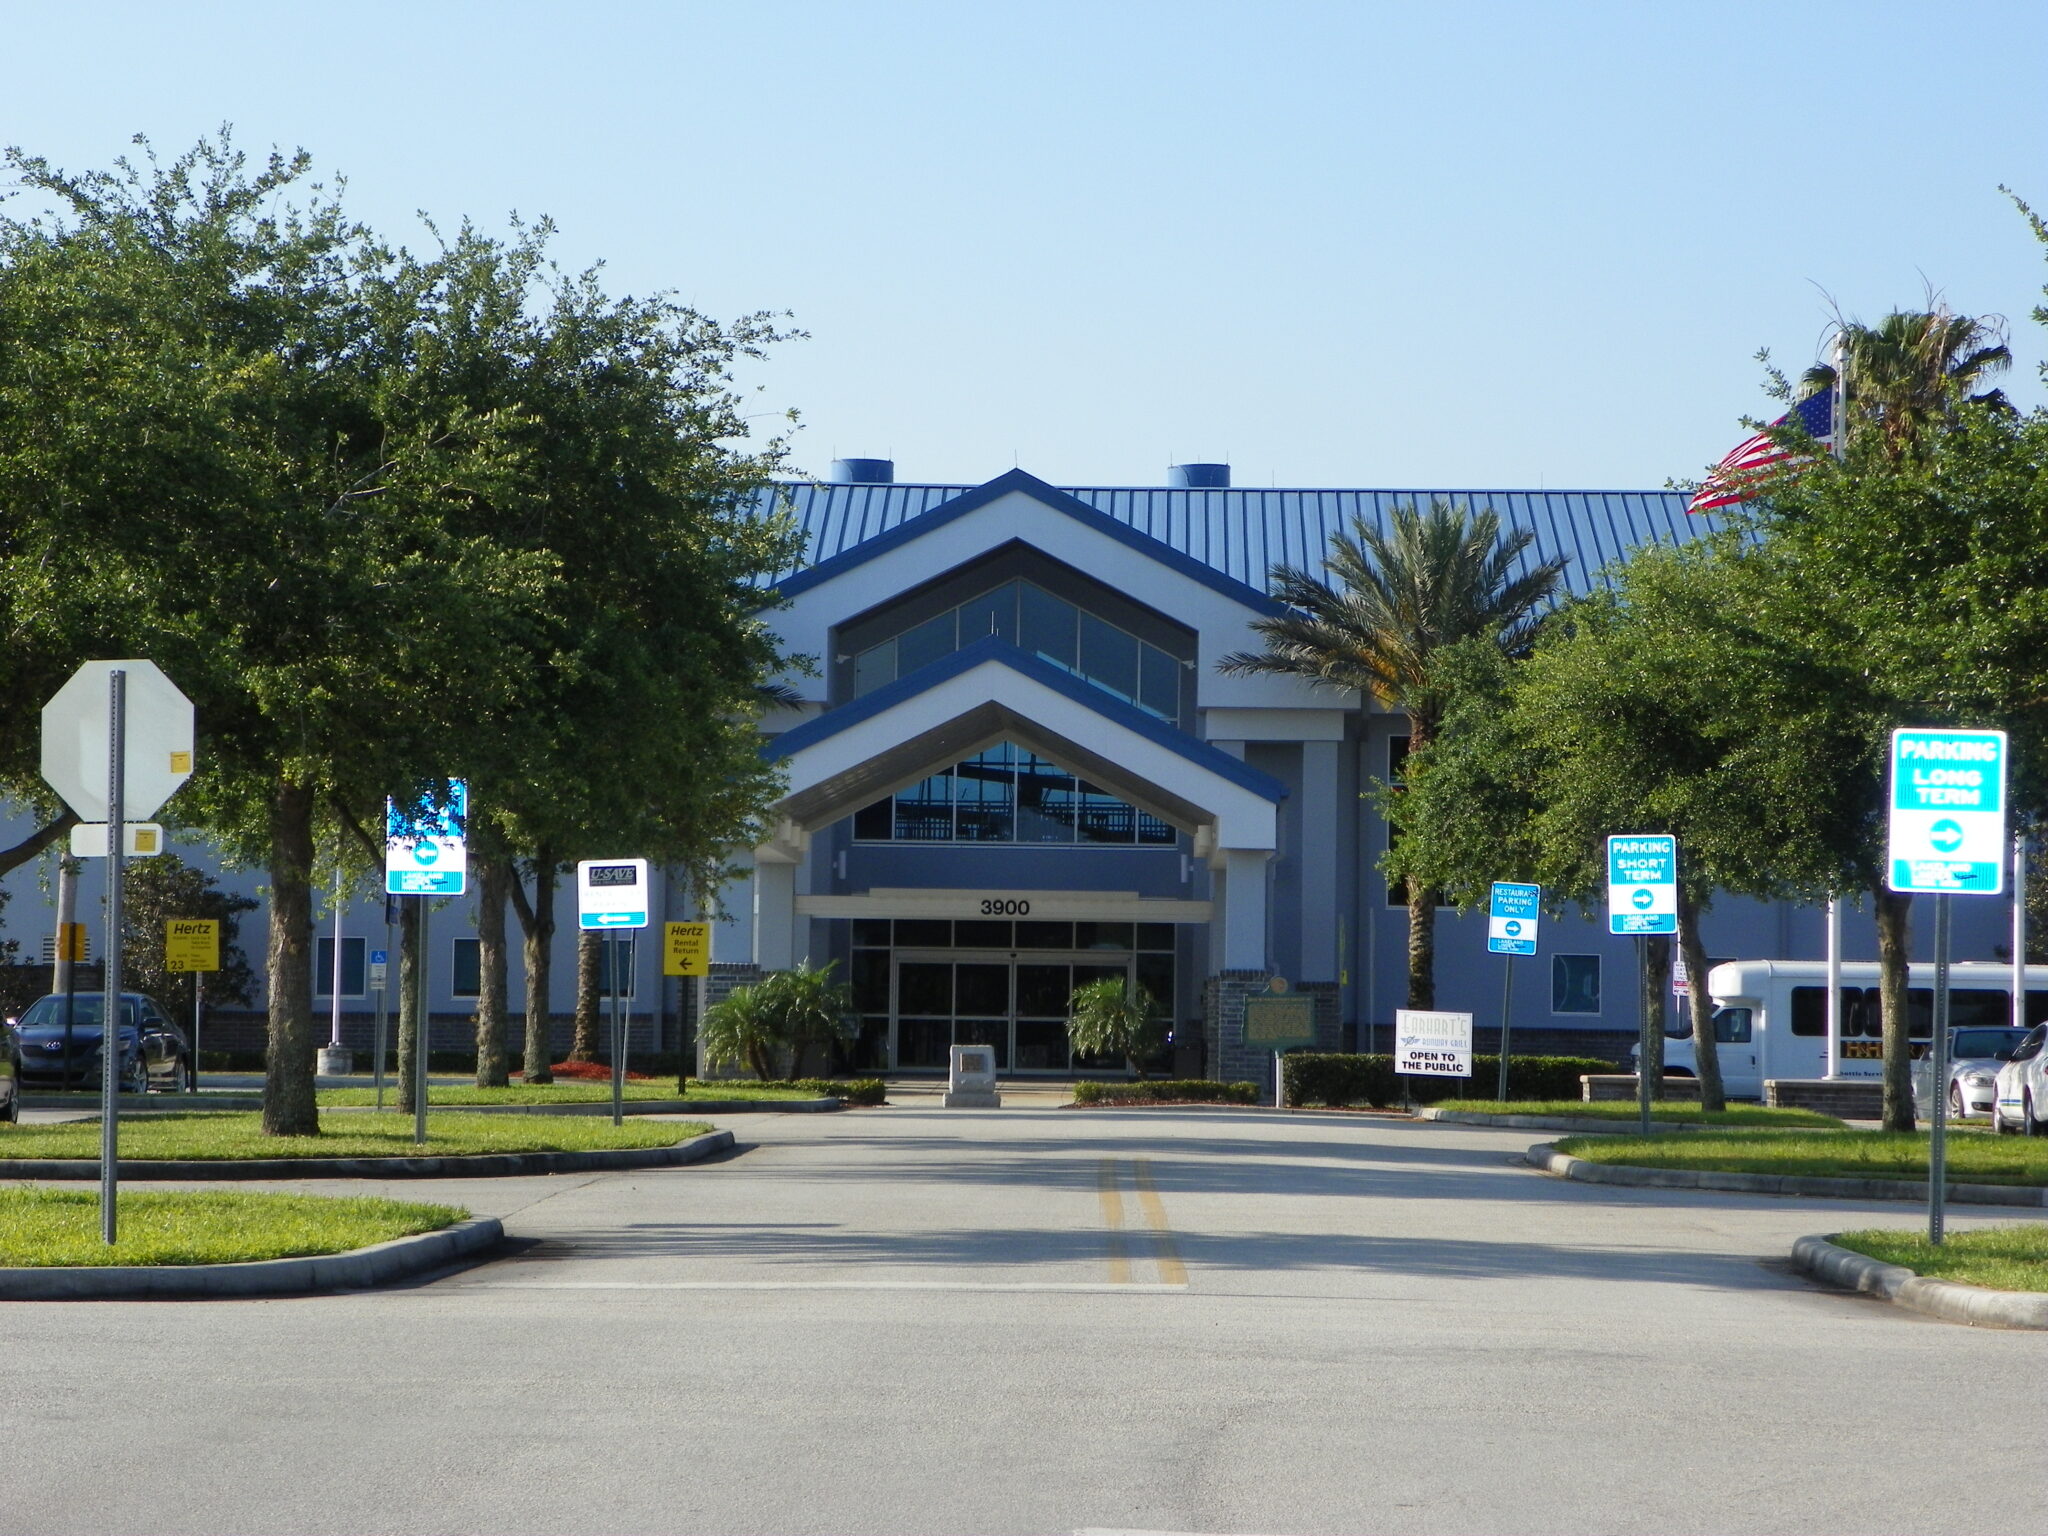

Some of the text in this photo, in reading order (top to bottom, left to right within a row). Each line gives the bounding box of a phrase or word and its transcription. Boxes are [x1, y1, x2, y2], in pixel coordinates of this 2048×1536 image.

[1900, 739, 1998, 762] PARKING
[1913, 768, 1983, 787] LONG
[1916, 787, 1981, 805] TERM
[1613, 842, 1671, 854] PARKING
[1617, 858, 1667, 869] SHORT
[591, 867, 636, 880] U-SAVE
[1624, 870, 1663, 881] TERM
[1494, 887, 1538, 898] RESTAURA
[1497, 896, 1533, 906] PARKING
[980, 899, 1030, 916] 3900
[1503, 905, 1525, 914] ONLY
[174, 922, 211, 935] Hertz
[670, 925, 704, 937] Hertz
[674, 939, 699, 947] Rental
[170, 960, 185, 970] 23
[1410, 1051, 1455, 1062] OPEN TO
[1402, 1061, 1464, 1073] THE PUBLIC
